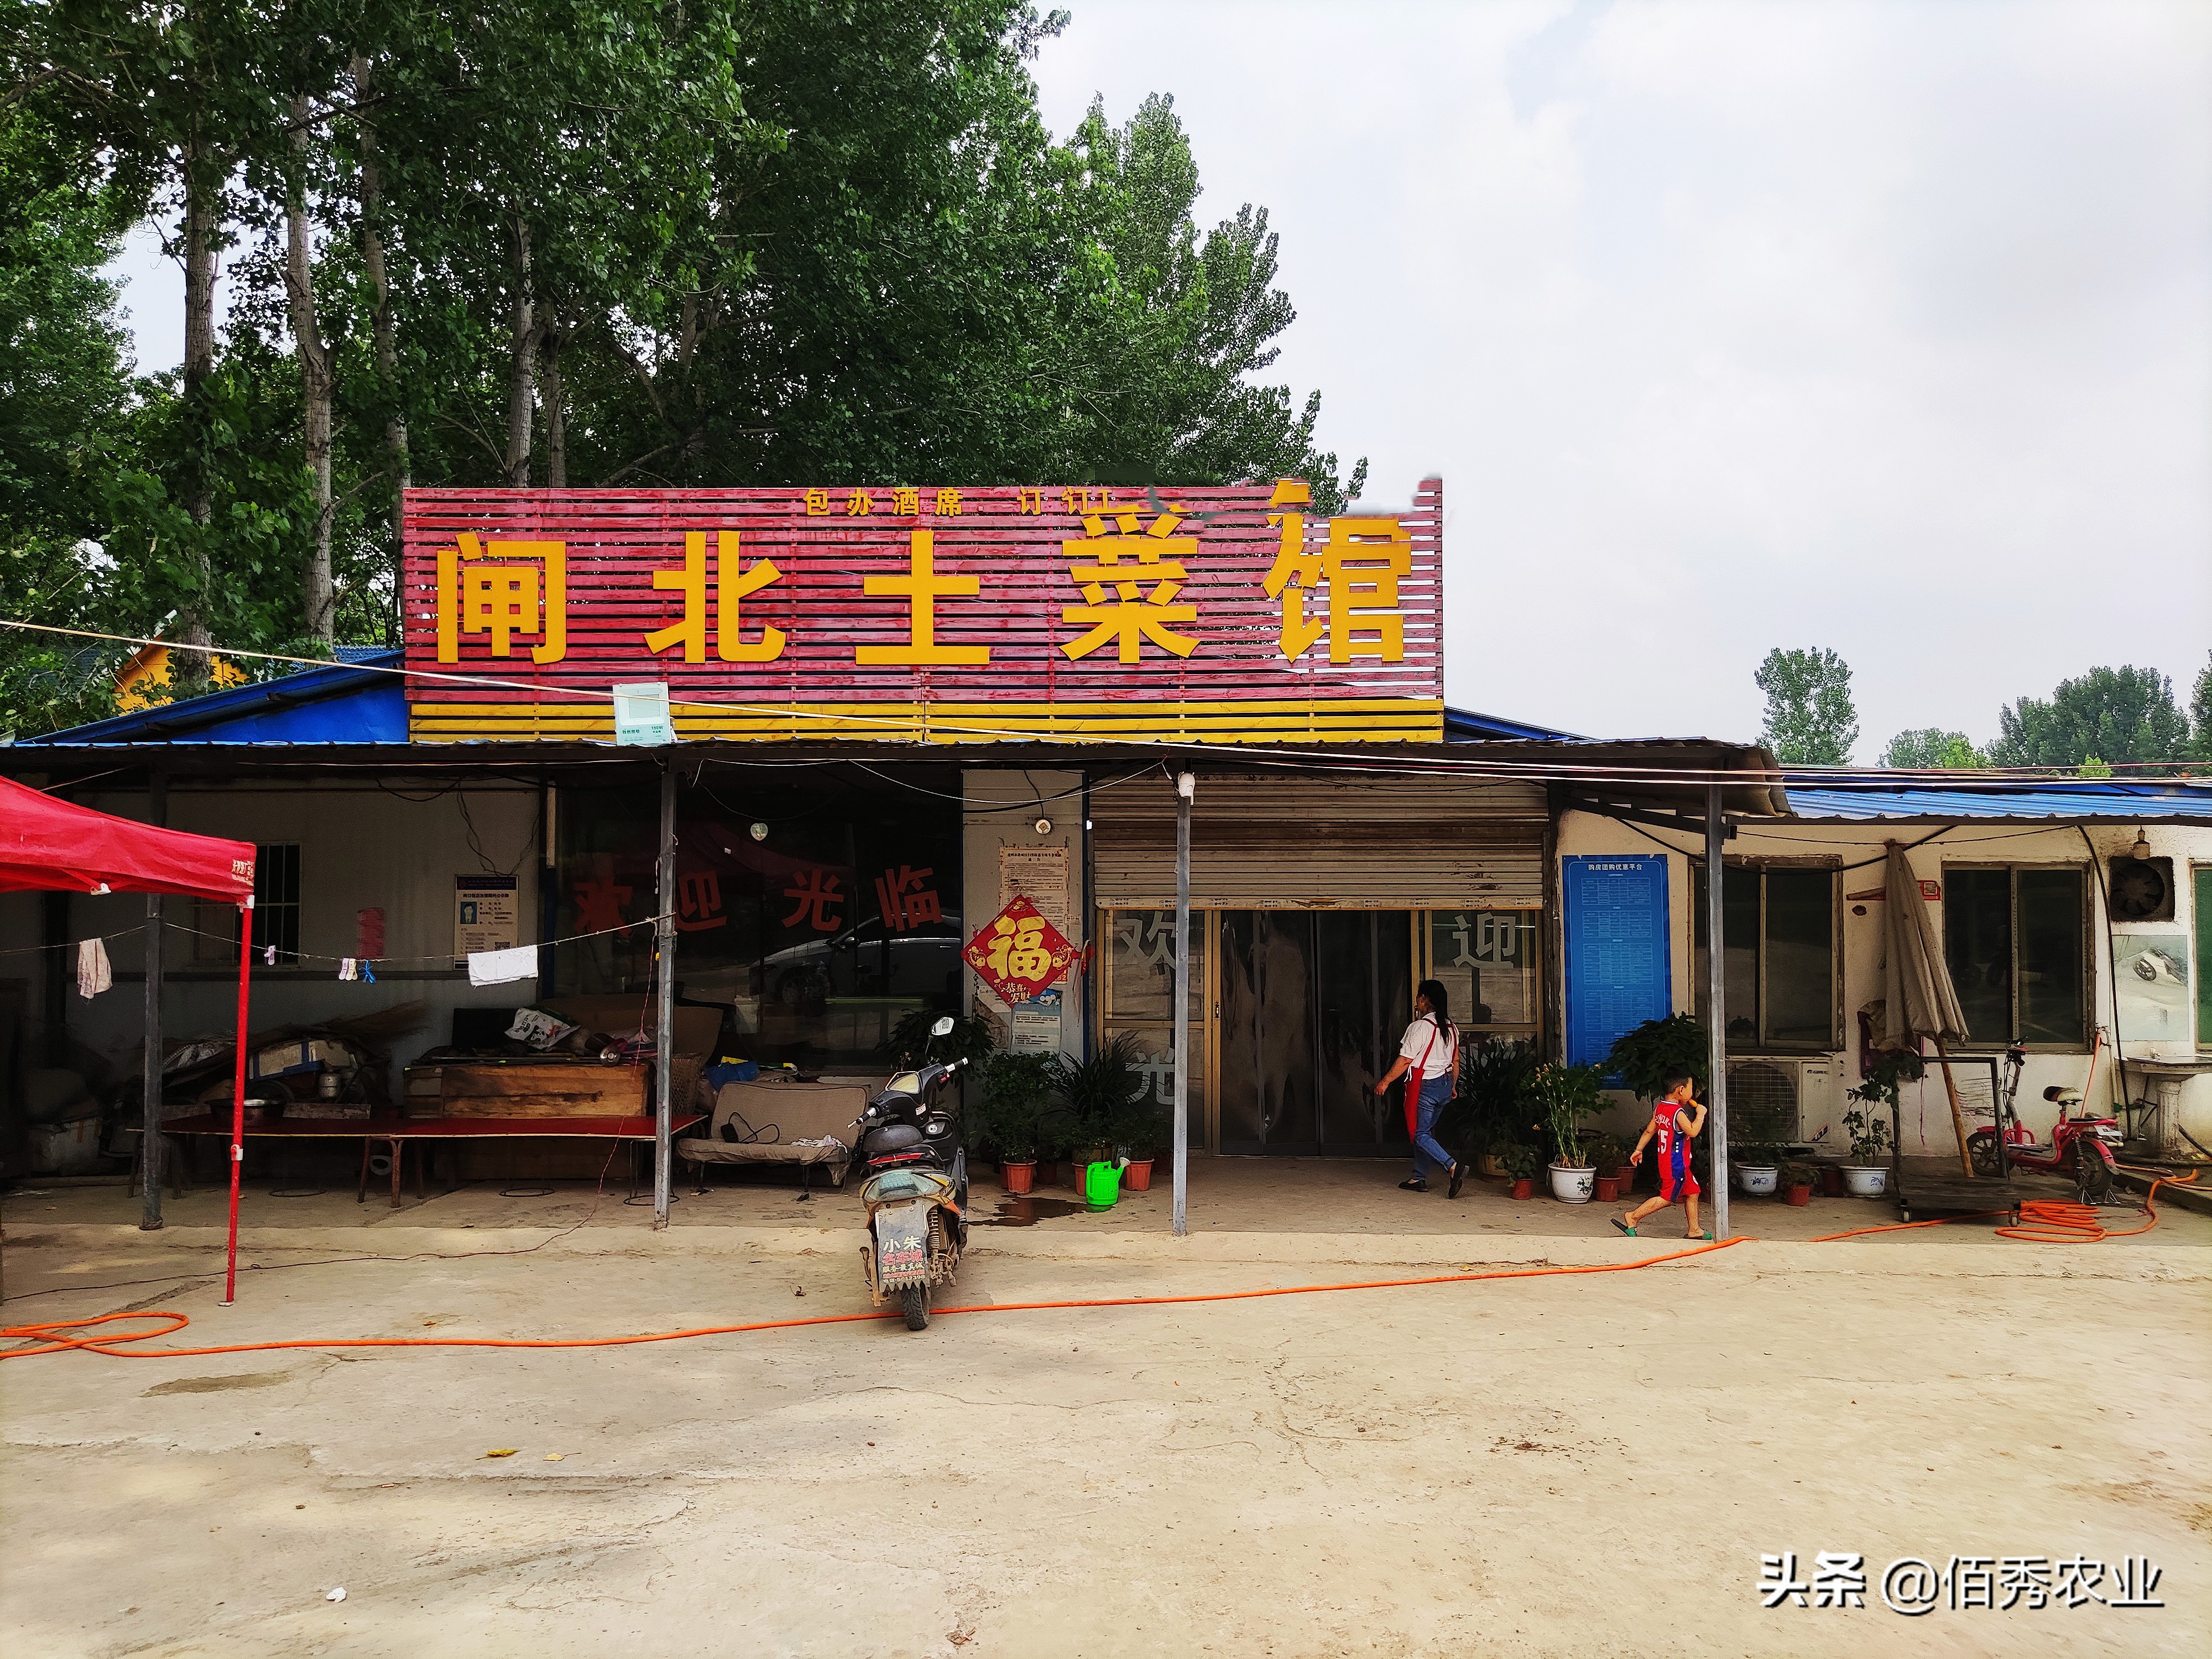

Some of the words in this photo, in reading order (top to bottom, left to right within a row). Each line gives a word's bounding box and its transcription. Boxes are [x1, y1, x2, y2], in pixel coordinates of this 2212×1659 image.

[802, 488, 964, 517] 包办酒席
[437, 477, 1412, 665] 闸北土菜馆
[573, 864, 942, 937] 欢迎光临
[987, 914, 1052, 982] 福
[1118, 911, 1176, 975] 欢
[1452, 912, 1516, 969] 迎
[1005, 982, 1024, 993] 恭喜
[1010, 991, 1031, 1002] 发财
[883, 1235, 922, 1253] 小朱
[883, 1249, 924, 1265] 名车城
